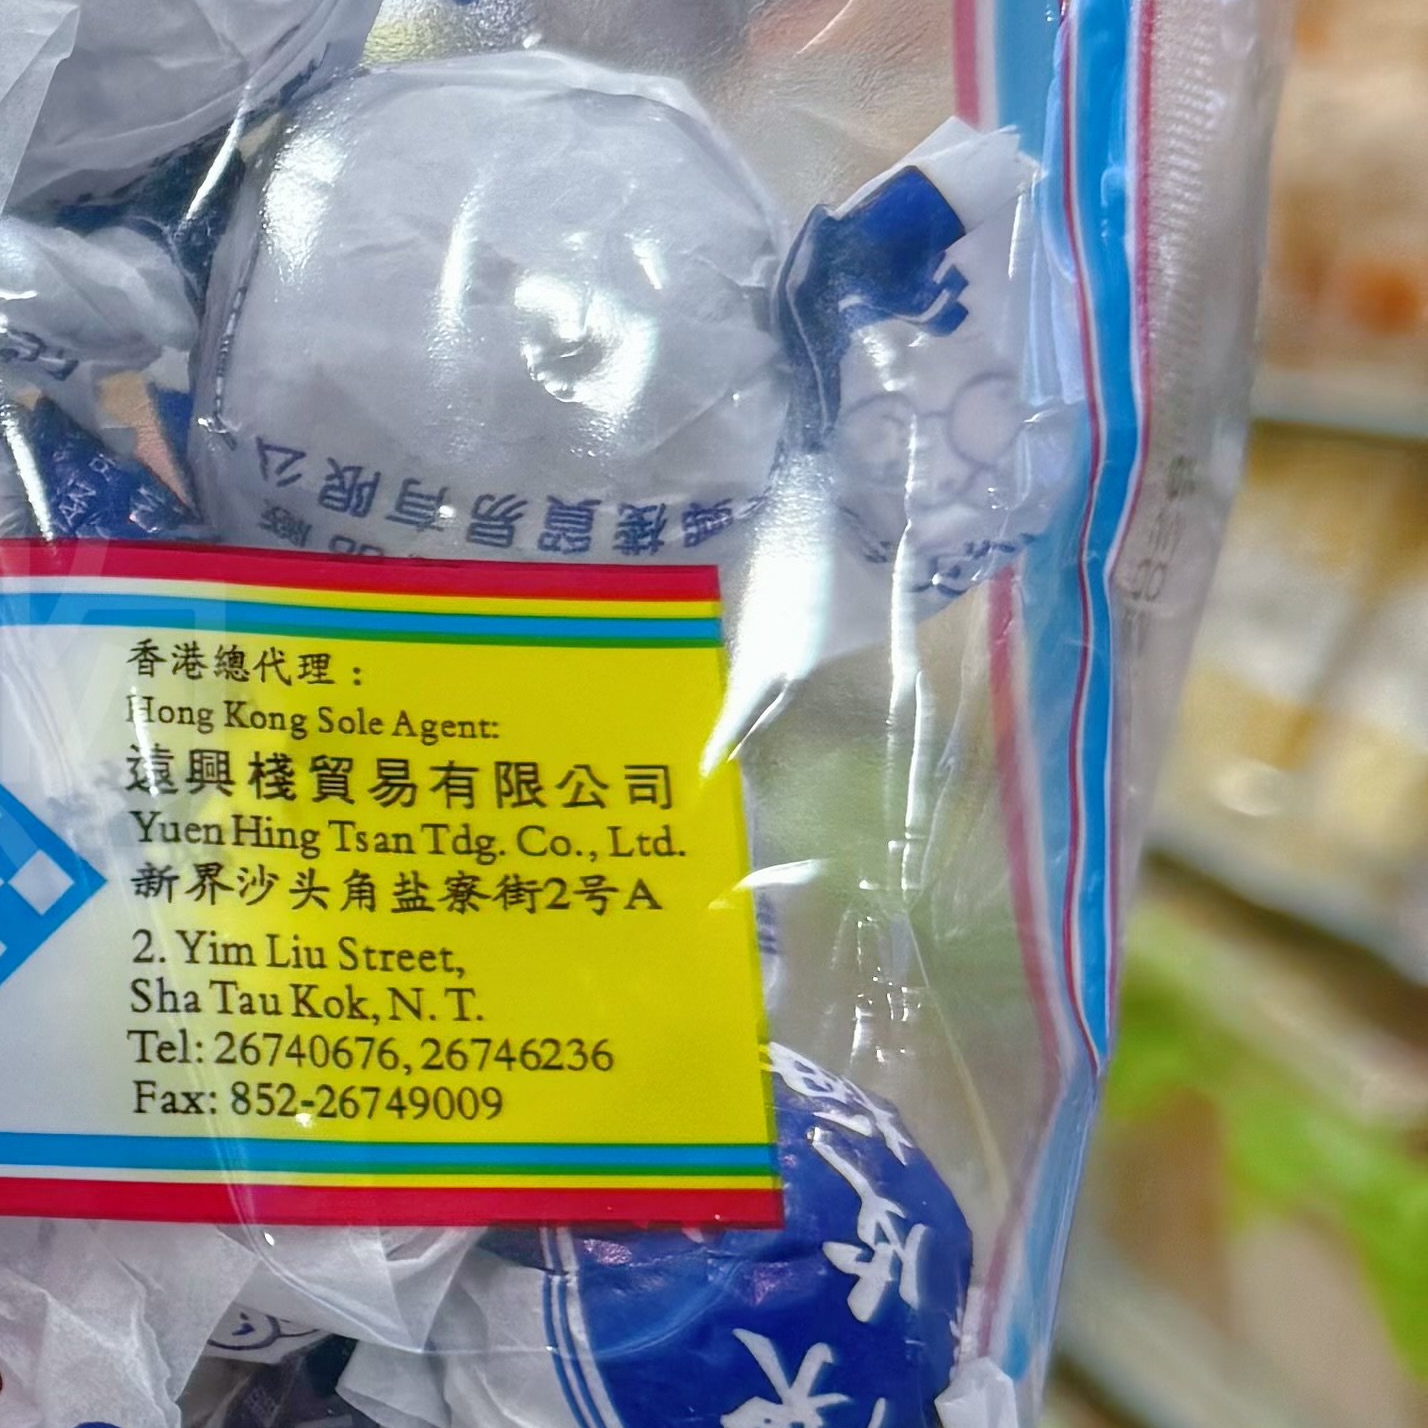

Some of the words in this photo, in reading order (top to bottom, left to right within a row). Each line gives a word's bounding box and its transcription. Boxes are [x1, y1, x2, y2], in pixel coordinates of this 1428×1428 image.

[125, 698, 213, 734] Hong
[224, 700, 308, 739] Kong
[317, 705, 383, 736] Sole
[392, 710, 500, 745] Agent:
[125, 746, 675, 811] 遠興棧貿易有限公司
[129, 812, 225, 849] Yuen
[232, 815, 320, 858] Hing
[327, 820, 414, 855] Tsan
[419, 823, 506, 864] Tdg.
[517, 826, 599, 864] Co.,
[608, 828, 686, 859] Ltd.
[132, 929, 166, 966] 2.
[175, 930, 253, 969] Yim
[266, 934, 325, 971] Liu
[338, 938, 466, 979] Street,
[130, 978, 201, 1016] Sha
[210, 980, 280, 1018] Tau
[290, 984, 379, 1024] Kok,
[127, 1030, 204, 1065] Tel:
[213, 1034, 412, 1077] 26740676,
[420, 1038, 614, 1073] 26746236
[132, 1082, 216, 1117] Fax:
[230, 1084, 503, 1121] 852-26749009
